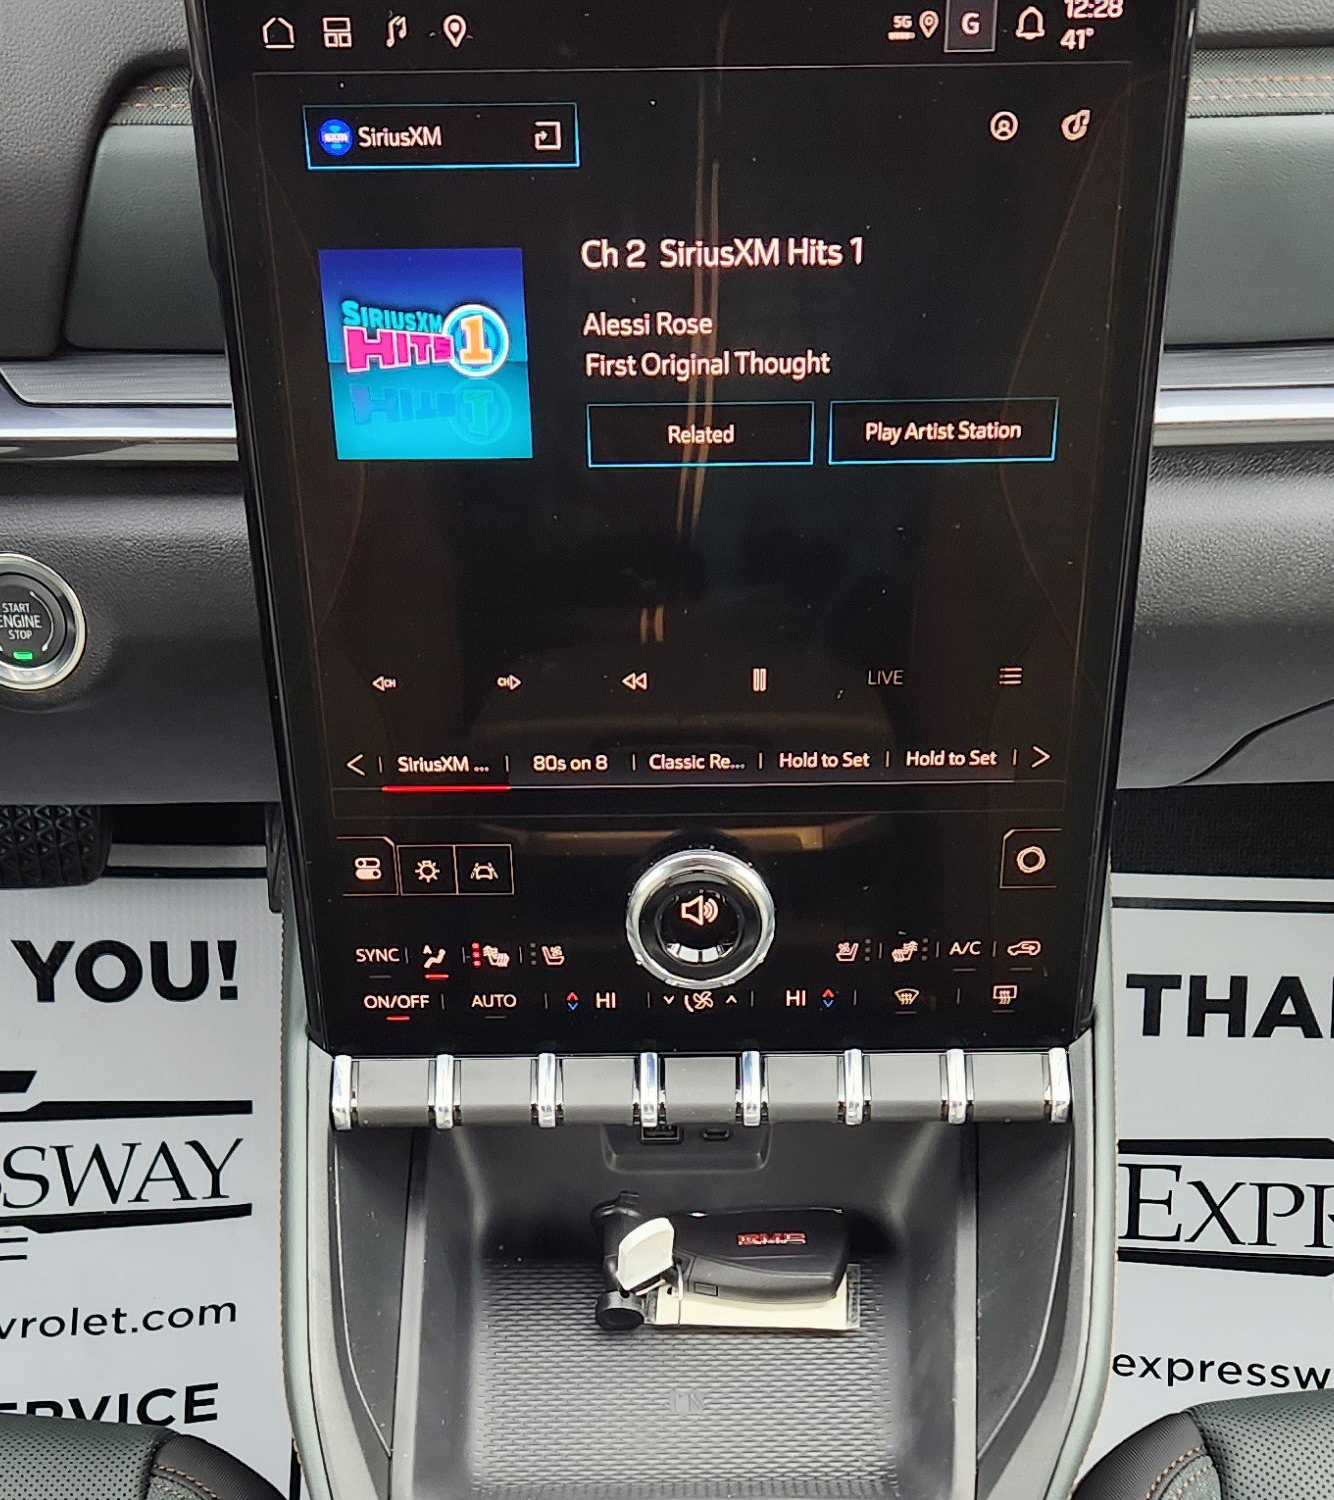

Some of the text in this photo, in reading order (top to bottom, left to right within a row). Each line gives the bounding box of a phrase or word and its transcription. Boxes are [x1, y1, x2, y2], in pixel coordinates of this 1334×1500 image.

[1064, 0, 1124, 19] 12:28
[961, 12, 980, 35] G
[358, 126, 442, 147] SiriusXM
[581, 237, 863, 268] Ch 2 SiriusXM Hits 1
[583, 311, 713, 337] Alessi Rose
[458, 314, 493, 365] 1
[343, 325, 454, 373] HITS
[585, 350, 831, 382] First Original Thought
[668, 424, 734, 445] Related
[865, 420, 1021, 445] Play Artist Station
[1, 603, 30, 613] START
[9, 630, 33, 640] STOP
[868, 670, 904, 685] LIVE
[397, 755, 469, 773] SiriusXM
[533, 754, 608, 772] 80s on 8
[649, 752, 705, 771] Classic
[779, 751, 870, 768] Hold to Set
[906, 750, 998, 766] Hold to Set
[356, 948, 400, 963] SYNC
[949, 941, 982, 956] A/C
[11, 939, 239, 1002] YOU!
[364, 994, 430, 1010] ON/OFF
[471, 993, 517, 1009] AUTO
[596, 992, 616, 1009] HI
[786, 989, 806, 1007] HI
